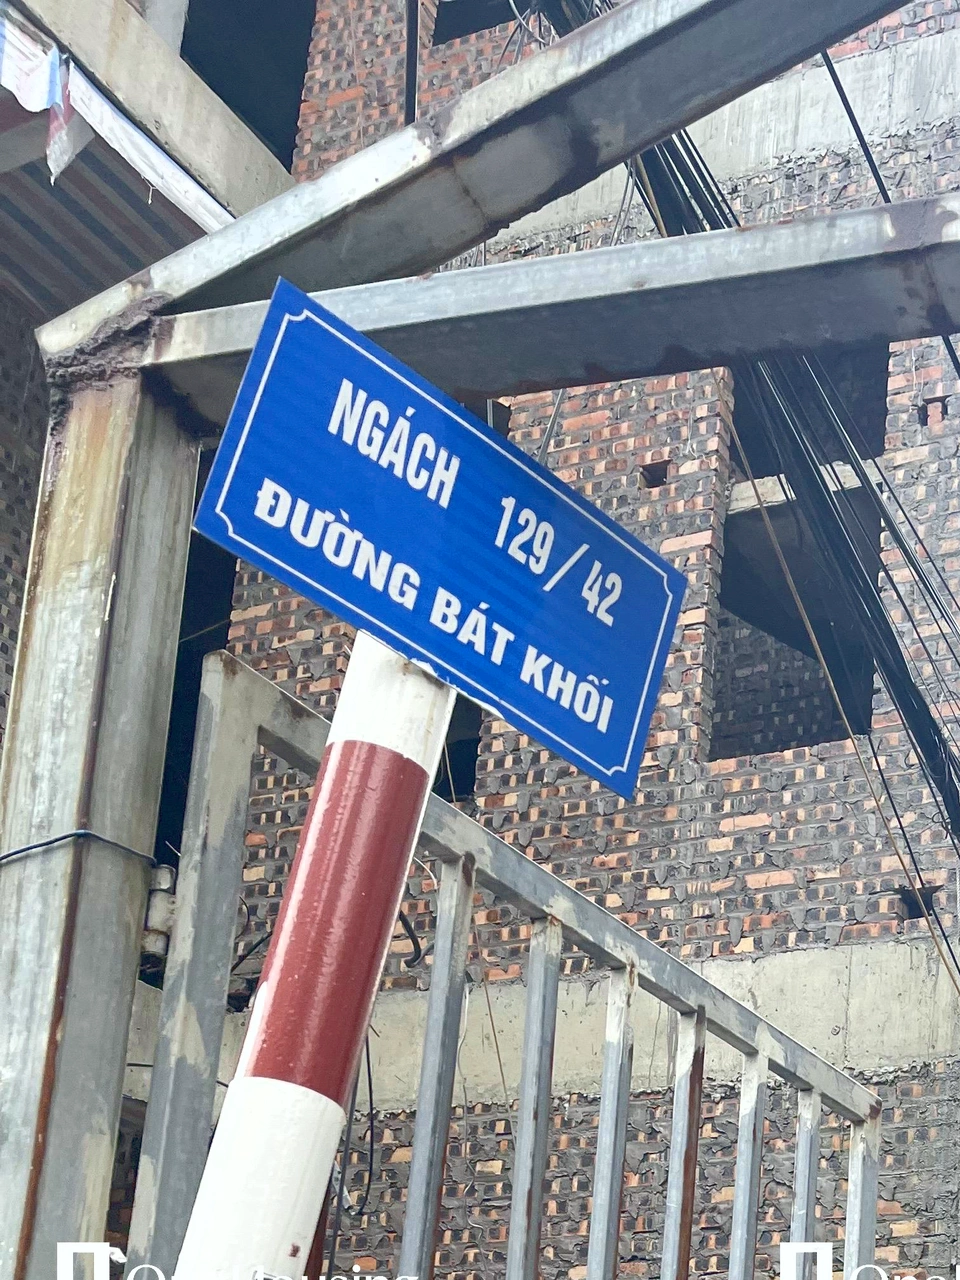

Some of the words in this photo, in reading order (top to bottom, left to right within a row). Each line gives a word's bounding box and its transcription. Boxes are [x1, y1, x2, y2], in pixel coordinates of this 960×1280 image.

[327, 378, 461, 509] NGÁCH
[254, 477, 421, 611] ĐƯỜNG
[428, 585, 515, 666] BÁT
[518, 646, 614, 734] KHỐI
